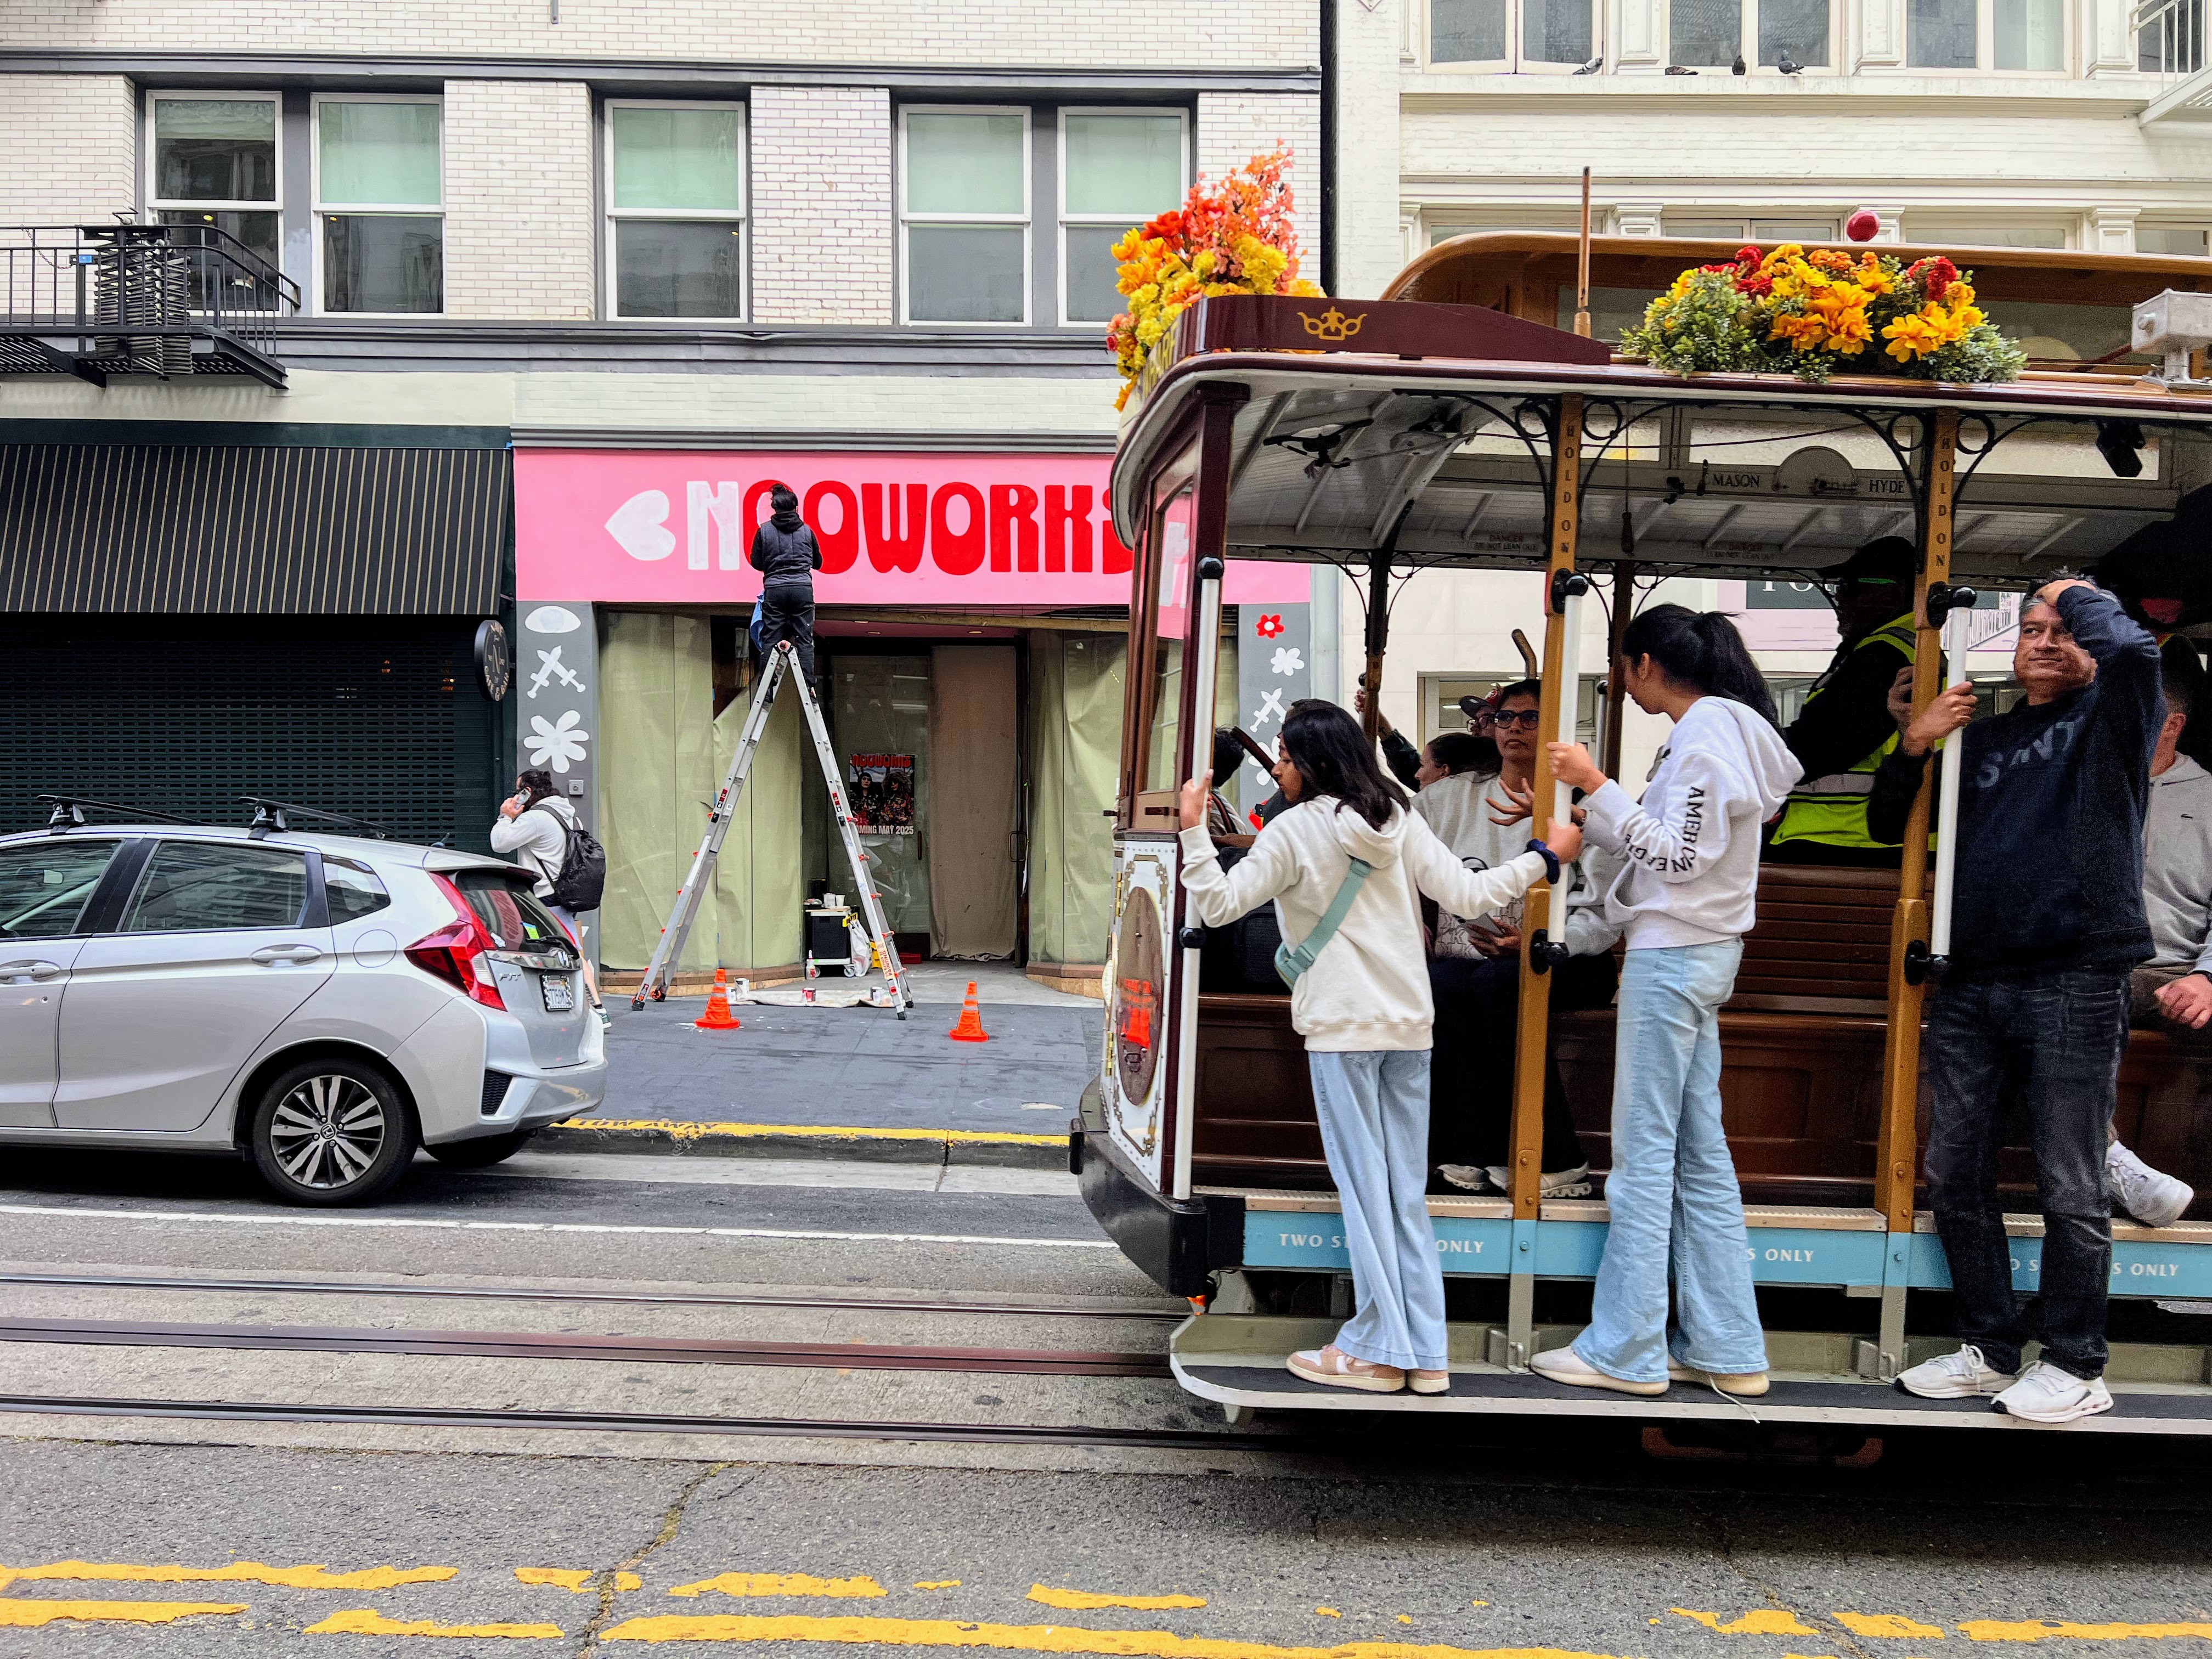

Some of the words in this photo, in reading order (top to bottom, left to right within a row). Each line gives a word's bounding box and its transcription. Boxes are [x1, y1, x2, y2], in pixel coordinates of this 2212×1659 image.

[1564, 425, 1575, 503] HOLD
[1713, 474, 1760, 488] MASON
[1938, 439, 1949, 516] HOLD
[1869, 479, 1905, 494] HYDE
[1561, 520, 1571, 554] ON
[1936, 533, 1946, 567] ON
[856, 825, 877, 834] MING
[878, 825, 894, 834] MAY
[896, 825, 914, 835] 2025
[1671, 786, 1705, 872] AMERCN
[882, 950, 893, 976] PAINTING
[499, 973, 521, 981] FIT
[1279, 1233, 1323, 1248] TWO
[1435, 1239, 1484, 1254] ONLY
[1765, 1248, 1814, 1263] ONLY
[2130, 1262, 2180, 1277] ONLY
